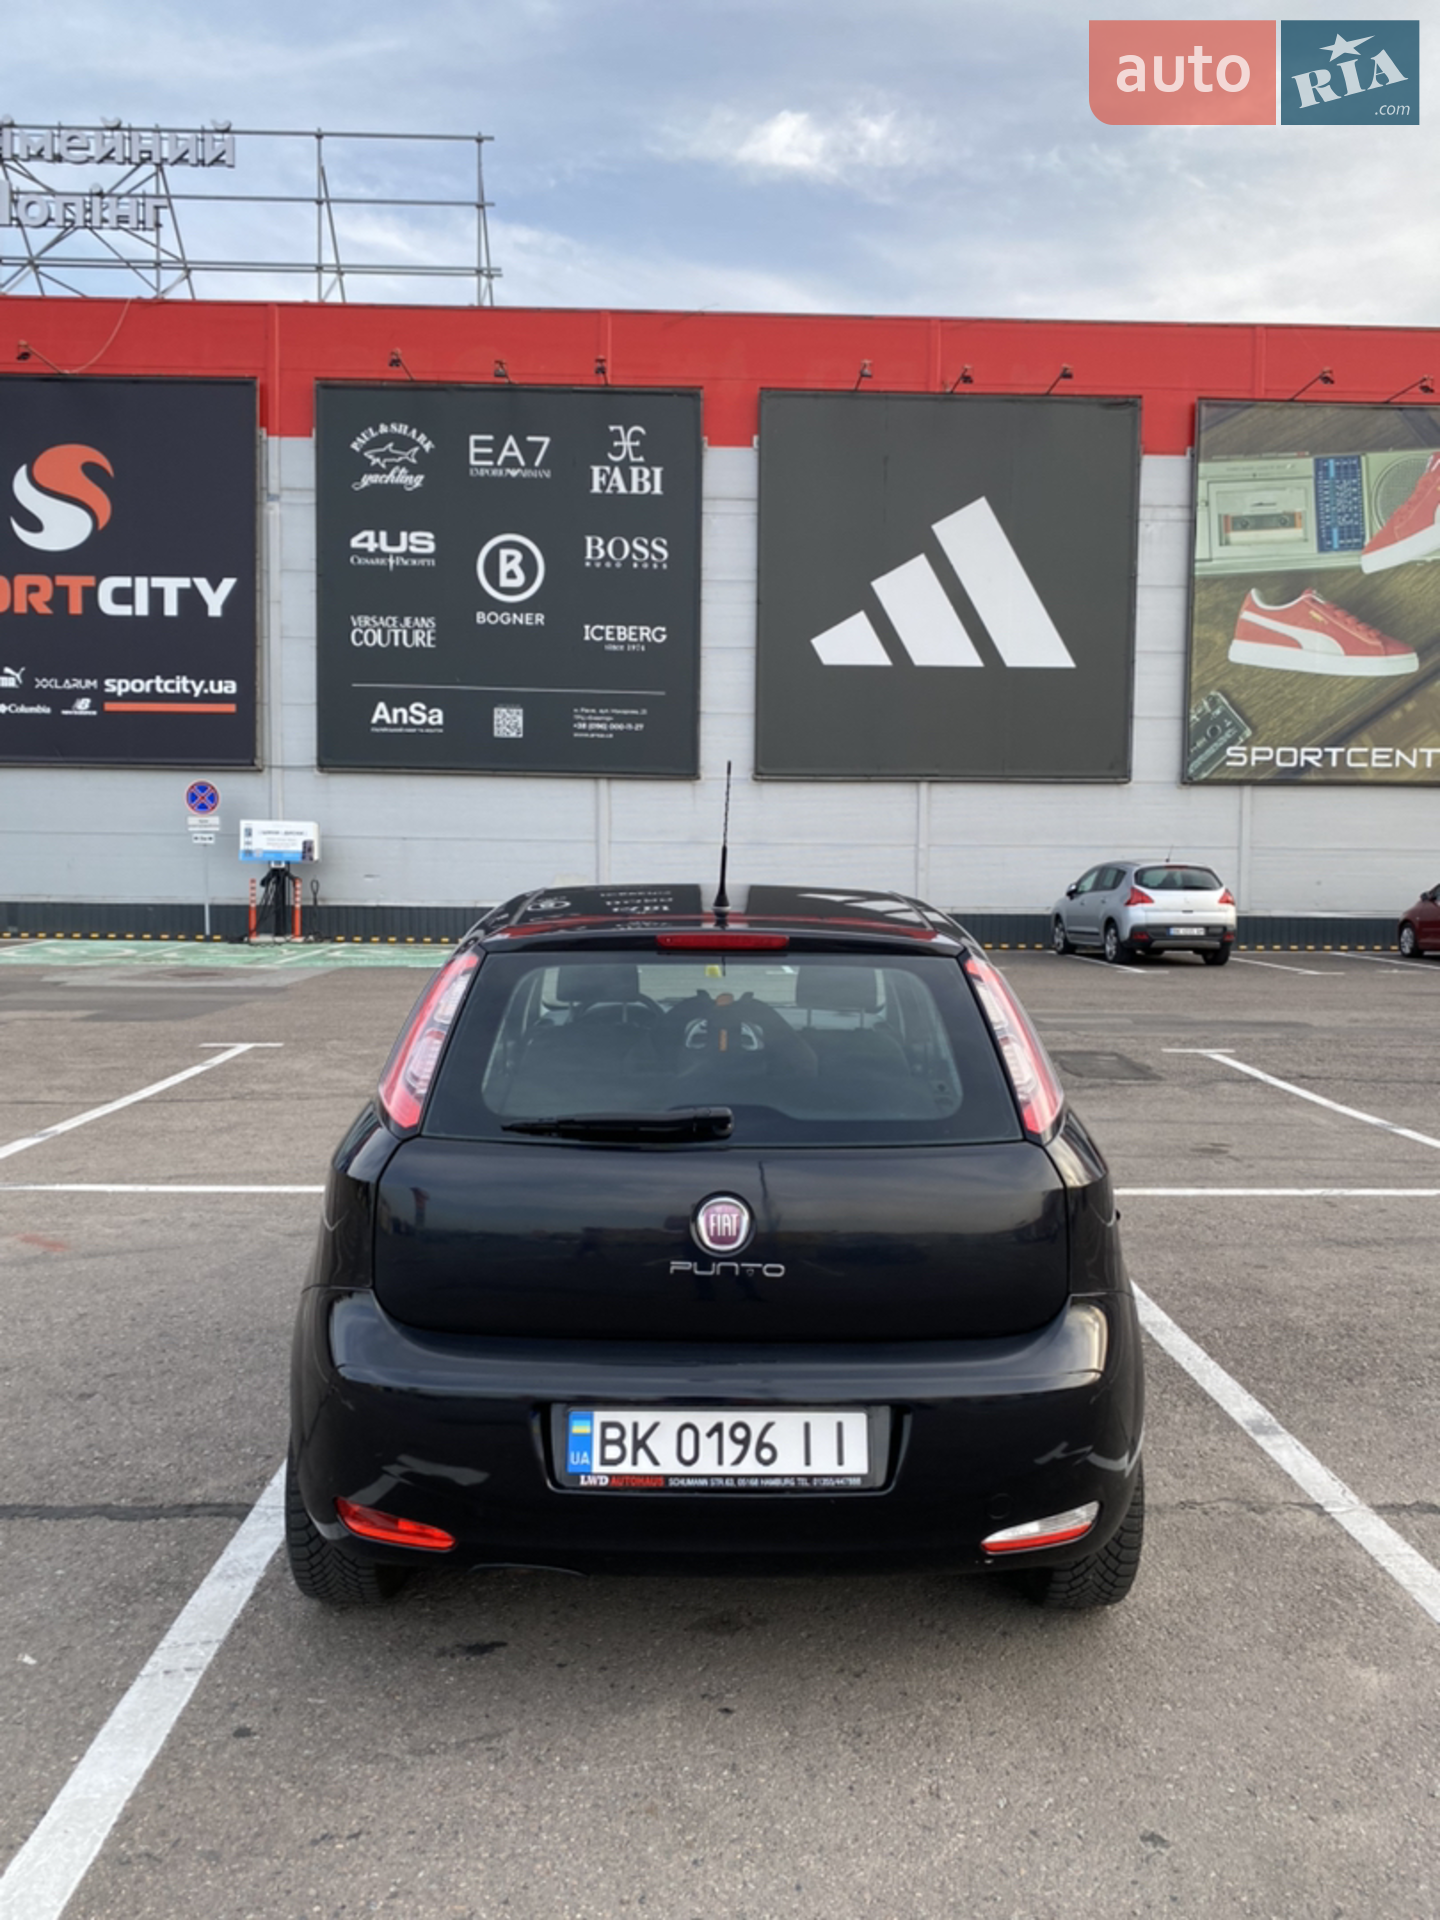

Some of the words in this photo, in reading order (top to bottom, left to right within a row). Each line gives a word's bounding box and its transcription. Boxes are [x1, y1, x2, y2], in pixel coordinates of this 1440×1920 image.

[0, 179, 168, 231] опінг
[469, 434, 551, 467] EA7
[351, 465, 425, 491] yachting
[590, 466, 664, 495] FABI
[350, 530, 436, 554] 4US
[585, 535, 669, 562] BOSS
[0, 574, 238, 617] RTCITY
[350, 615, 399, 628] VERSACE
[400, 616, 436, 629] JEANS
[476, 611, 545, 626] BOGNER
[350, 628, 436, 648] COUTURE
[583, 624, 667, 643] ICEBERG
[104, 676, 237, 697] sportcity.ua
[371, 701, 444, 726] AnSa
[709, 1213, 739, 1237] FIAT
[669, 1260, 785, 1277] PUNTO
[600, 1421, 661, 1467] BK
[676, 1421, 778, 1468] 0196
[570, 1452, 590, 1466] UA
[610, 1475, 665, 1487] AUTOHAUS
